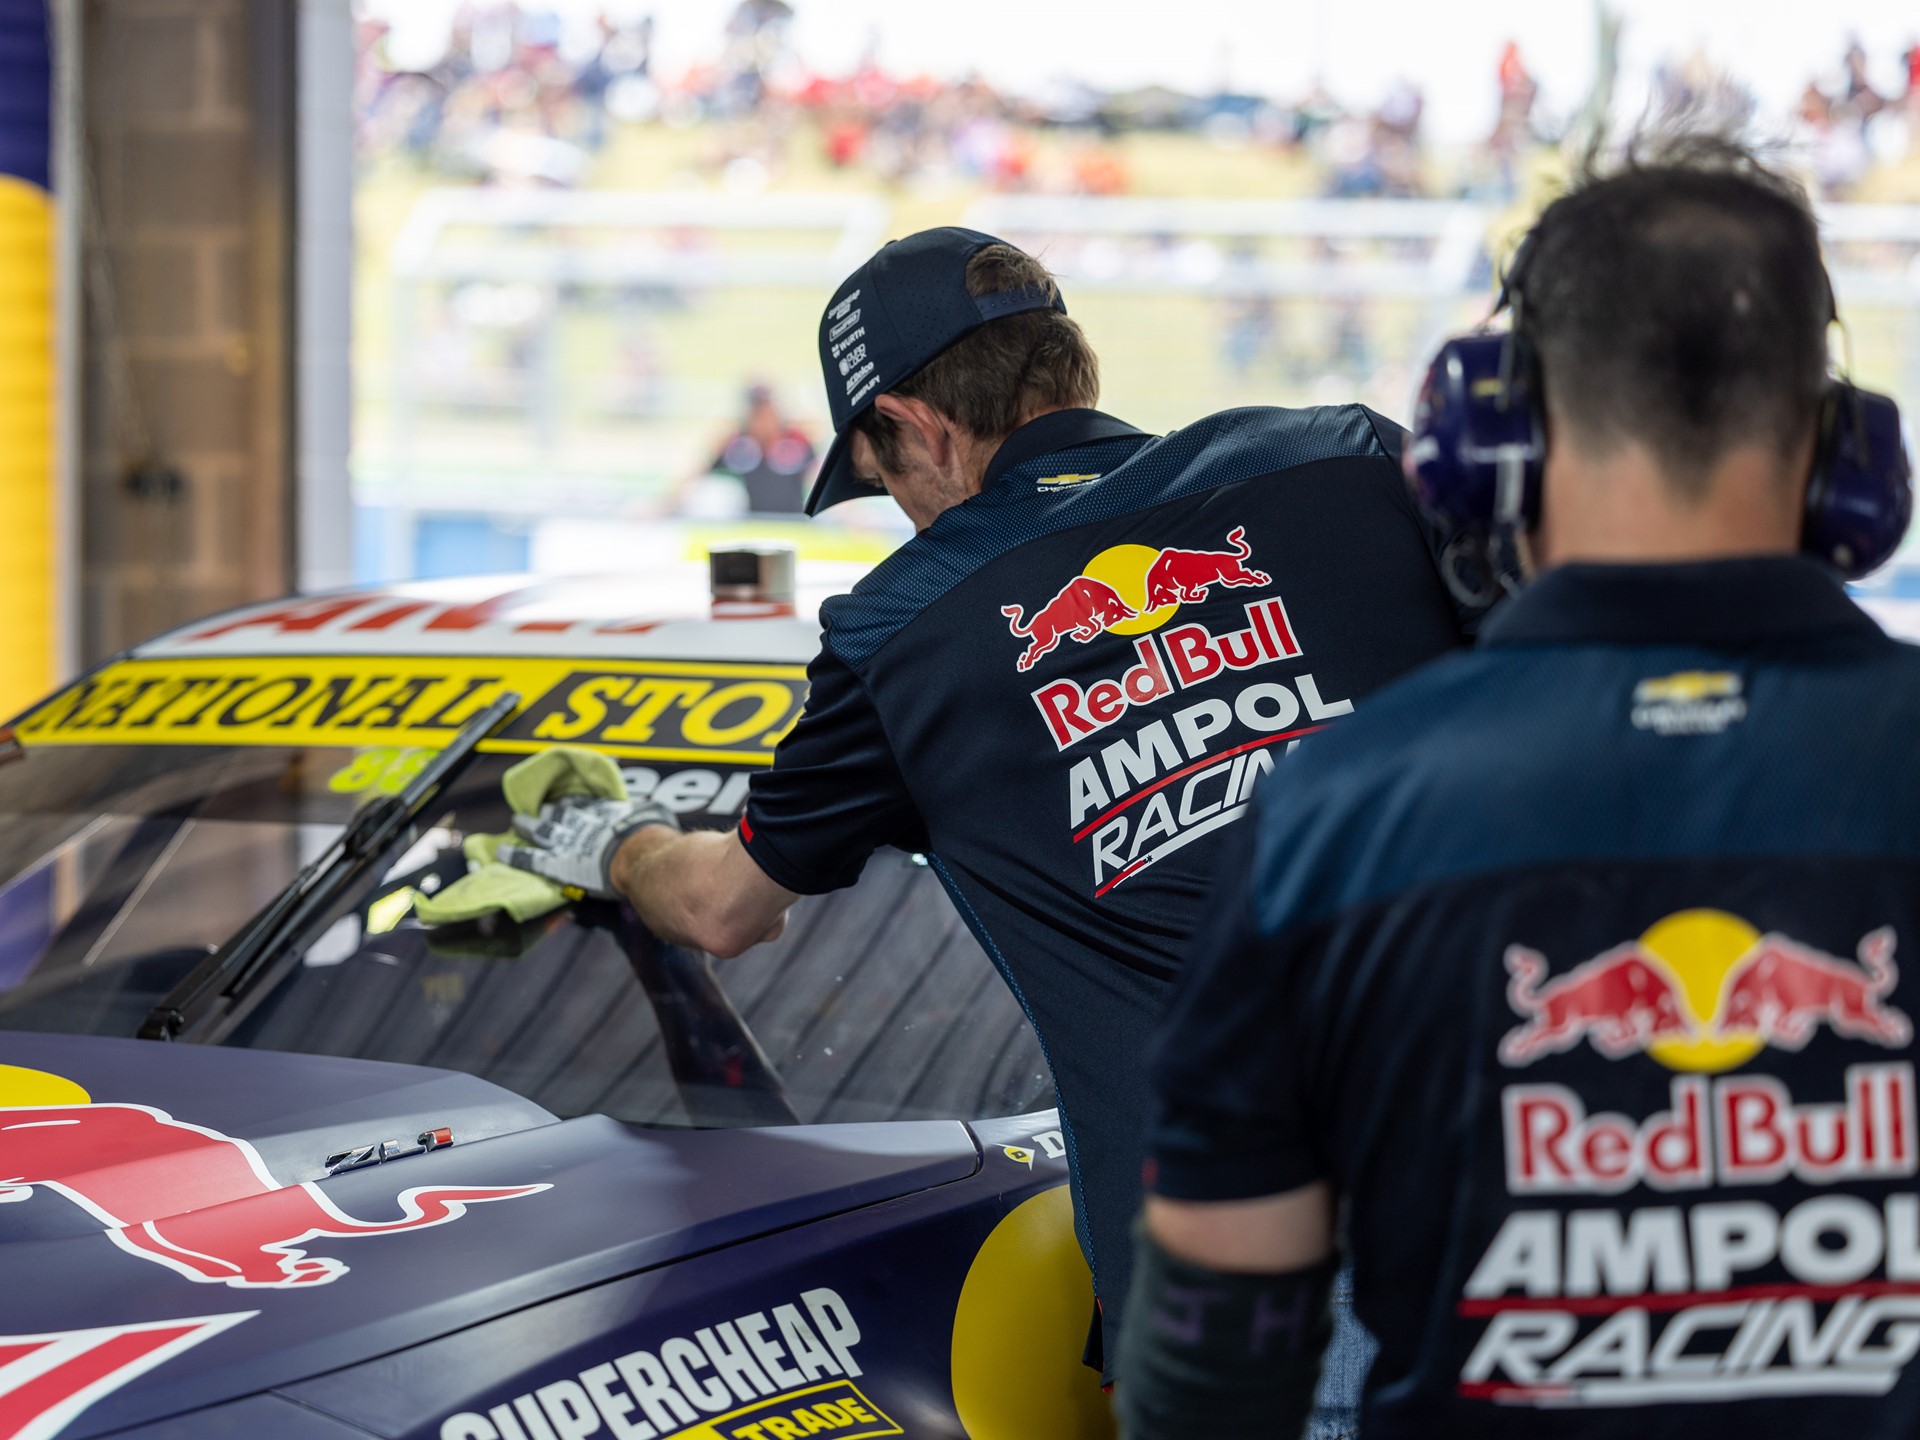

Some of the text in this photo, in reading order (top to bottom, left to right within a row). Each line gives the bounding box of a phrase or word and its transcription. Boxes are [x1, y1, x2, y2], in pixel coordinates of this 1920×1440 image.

[22, 674, 505, 735] NATIONAL
[1031, 597, 1303, 752] Red Bull
[1070, 673, 1354, 829] AMPOL
[1092, 739, 1300, 887] RACIN
[1502, 1061, 1917, 1195] Red Bull
[1463, 1193, 1920, 1298] AMPOL
[1460, 1296, 1920, 1384] RACING
